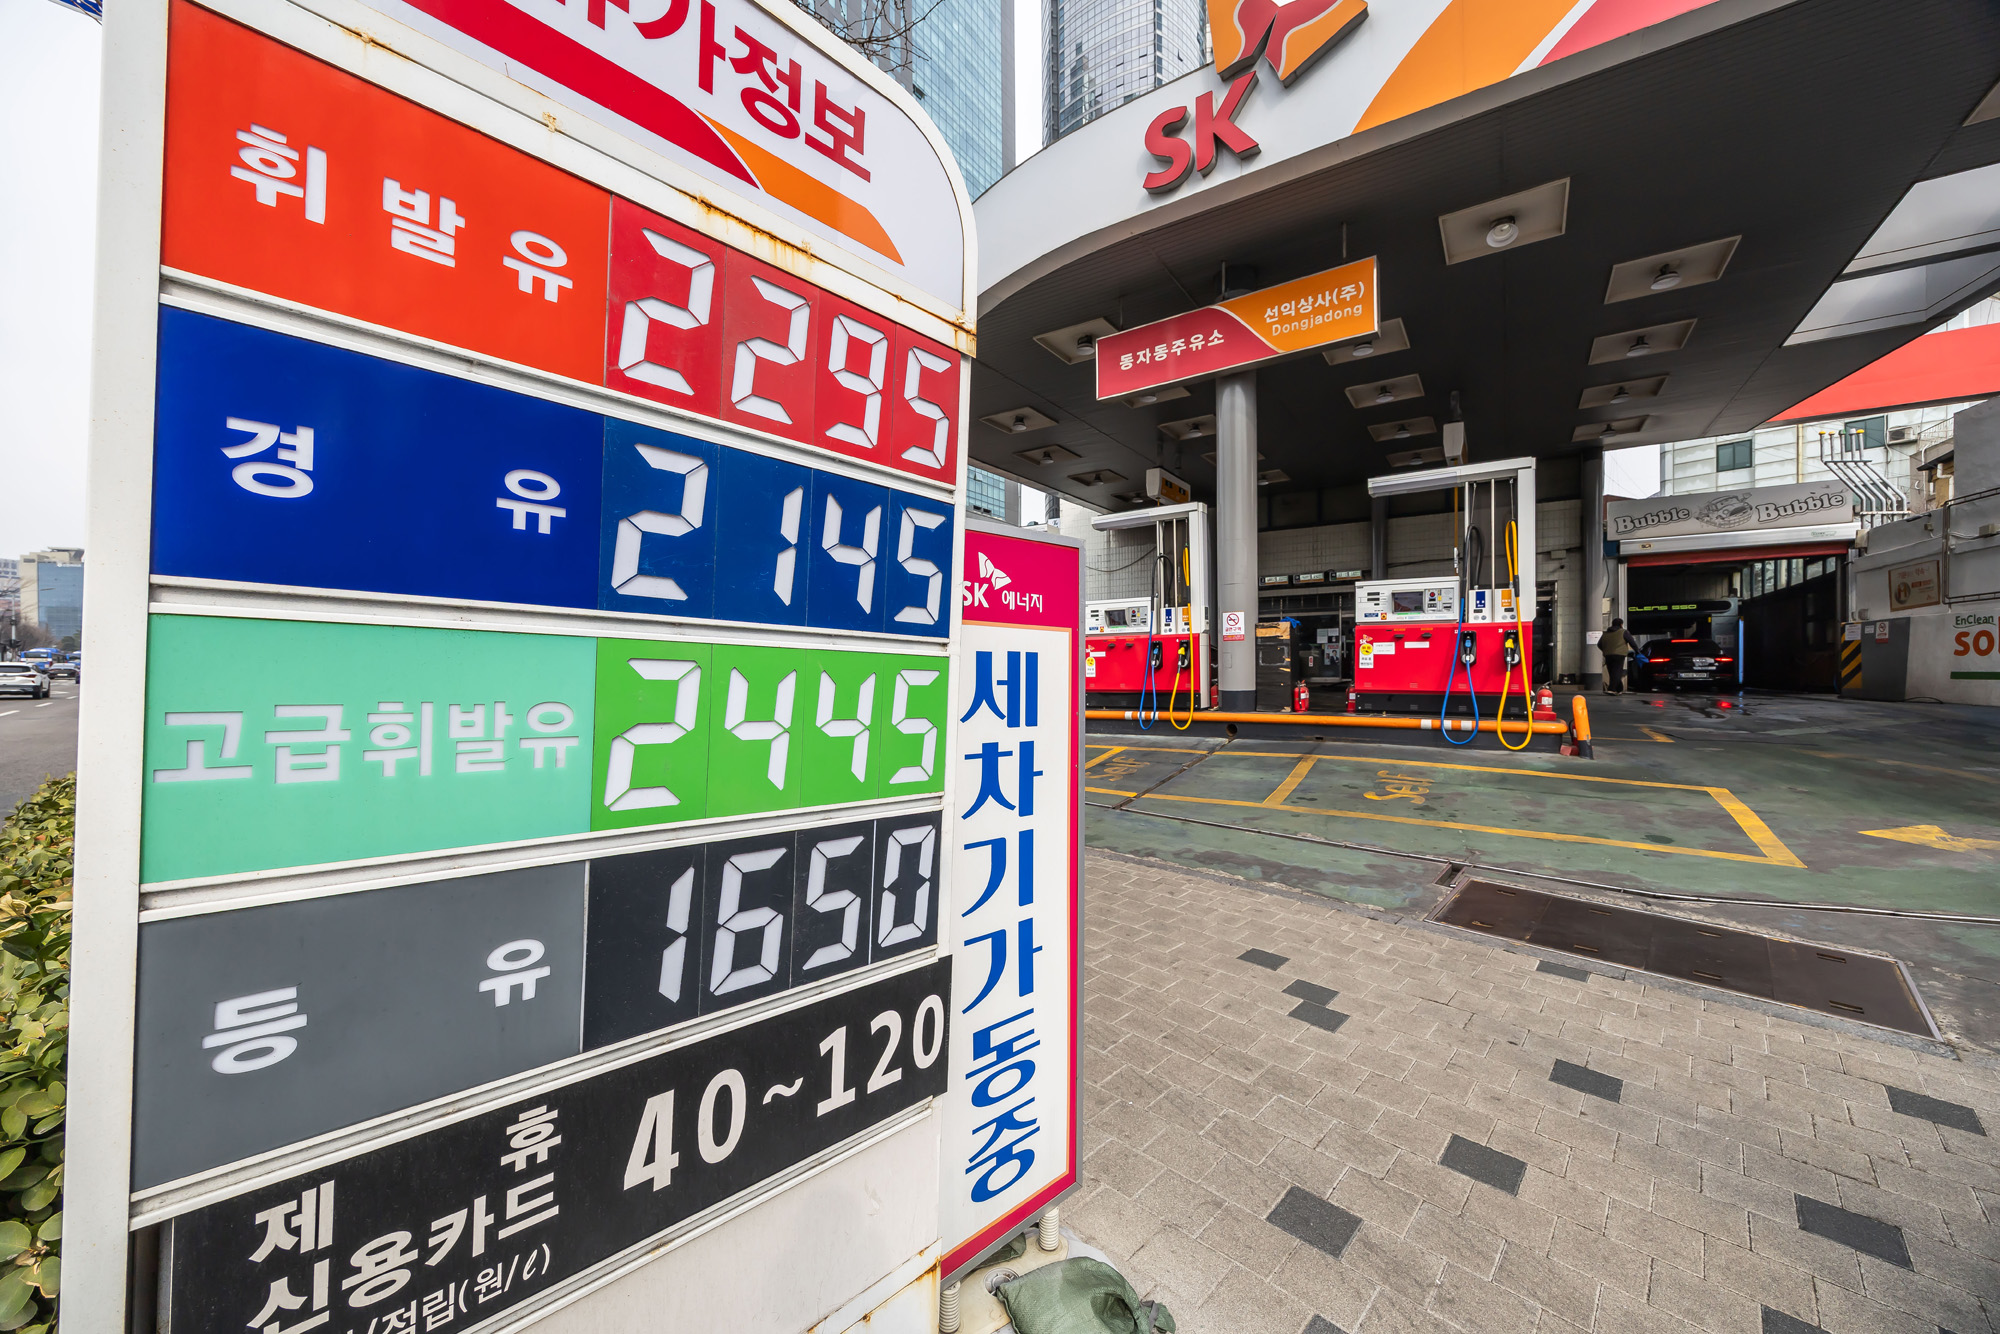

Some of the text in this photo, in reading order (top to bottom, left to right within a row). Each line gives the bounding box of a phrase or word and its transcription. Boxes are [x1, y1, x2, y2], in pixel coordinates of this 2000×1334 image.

[548, 0, 871, 183] 가정보
[1143, 70, 1261, 192] SK
[231, 123, 952, 469] 휘발유 2295
[1119, 329, 1225, 371] 동자동주유소
[1264, 282, 1364, 323] 선익상사(주)
[1272, 305, 1362, 336] Dongjadong
[611, 443, 946, 625] 2145
[1615, 493, 1845, 535] Bubble Bubble
[962, 580, 1043, 613] SK 에너지
[1953, 616, 2000, 657] SO
[1955, 613, 1994, 626] EnClean
[153, 657, 941, 812] 고급휘발유 2445
[658, 824, 936, 1003] 1650
[959, 649, 1044, 1205] 세차기가동중
[246, 1172, 560, 1334] 신용카드
